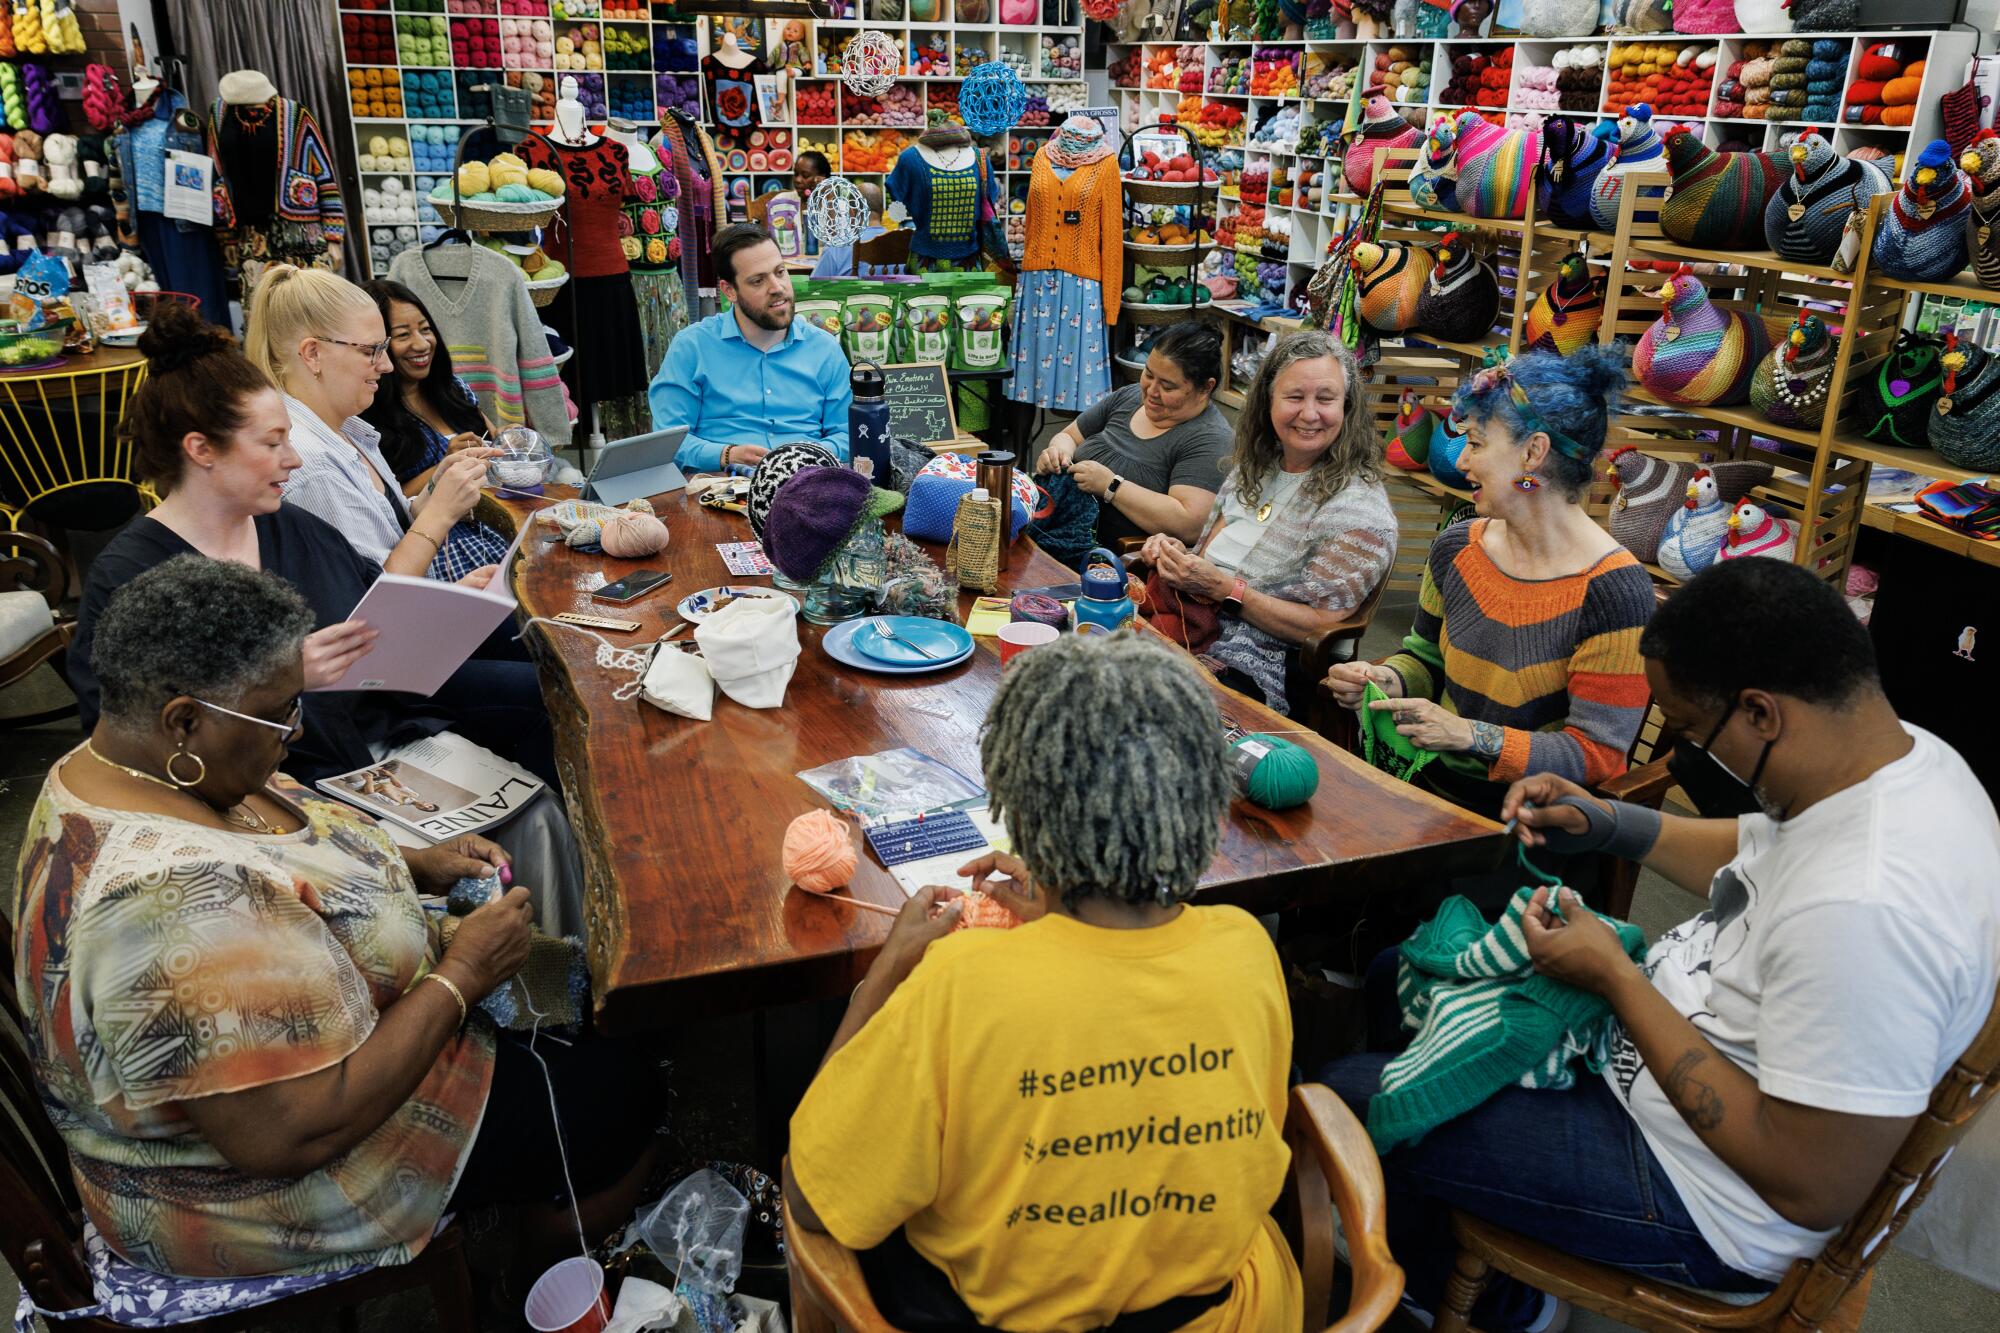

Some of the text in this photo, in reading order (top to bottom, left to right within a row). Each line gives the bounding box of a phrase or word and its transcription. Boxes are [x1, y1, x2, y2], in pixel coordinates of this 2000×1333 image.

[1600, 175, 1621, 201] 17
[420, 776, 538, 835] LAINE
[1019, 1042, 1234, 1098] #seemycolor
[1006, 1184, 1217, 1229] #seeallofme
